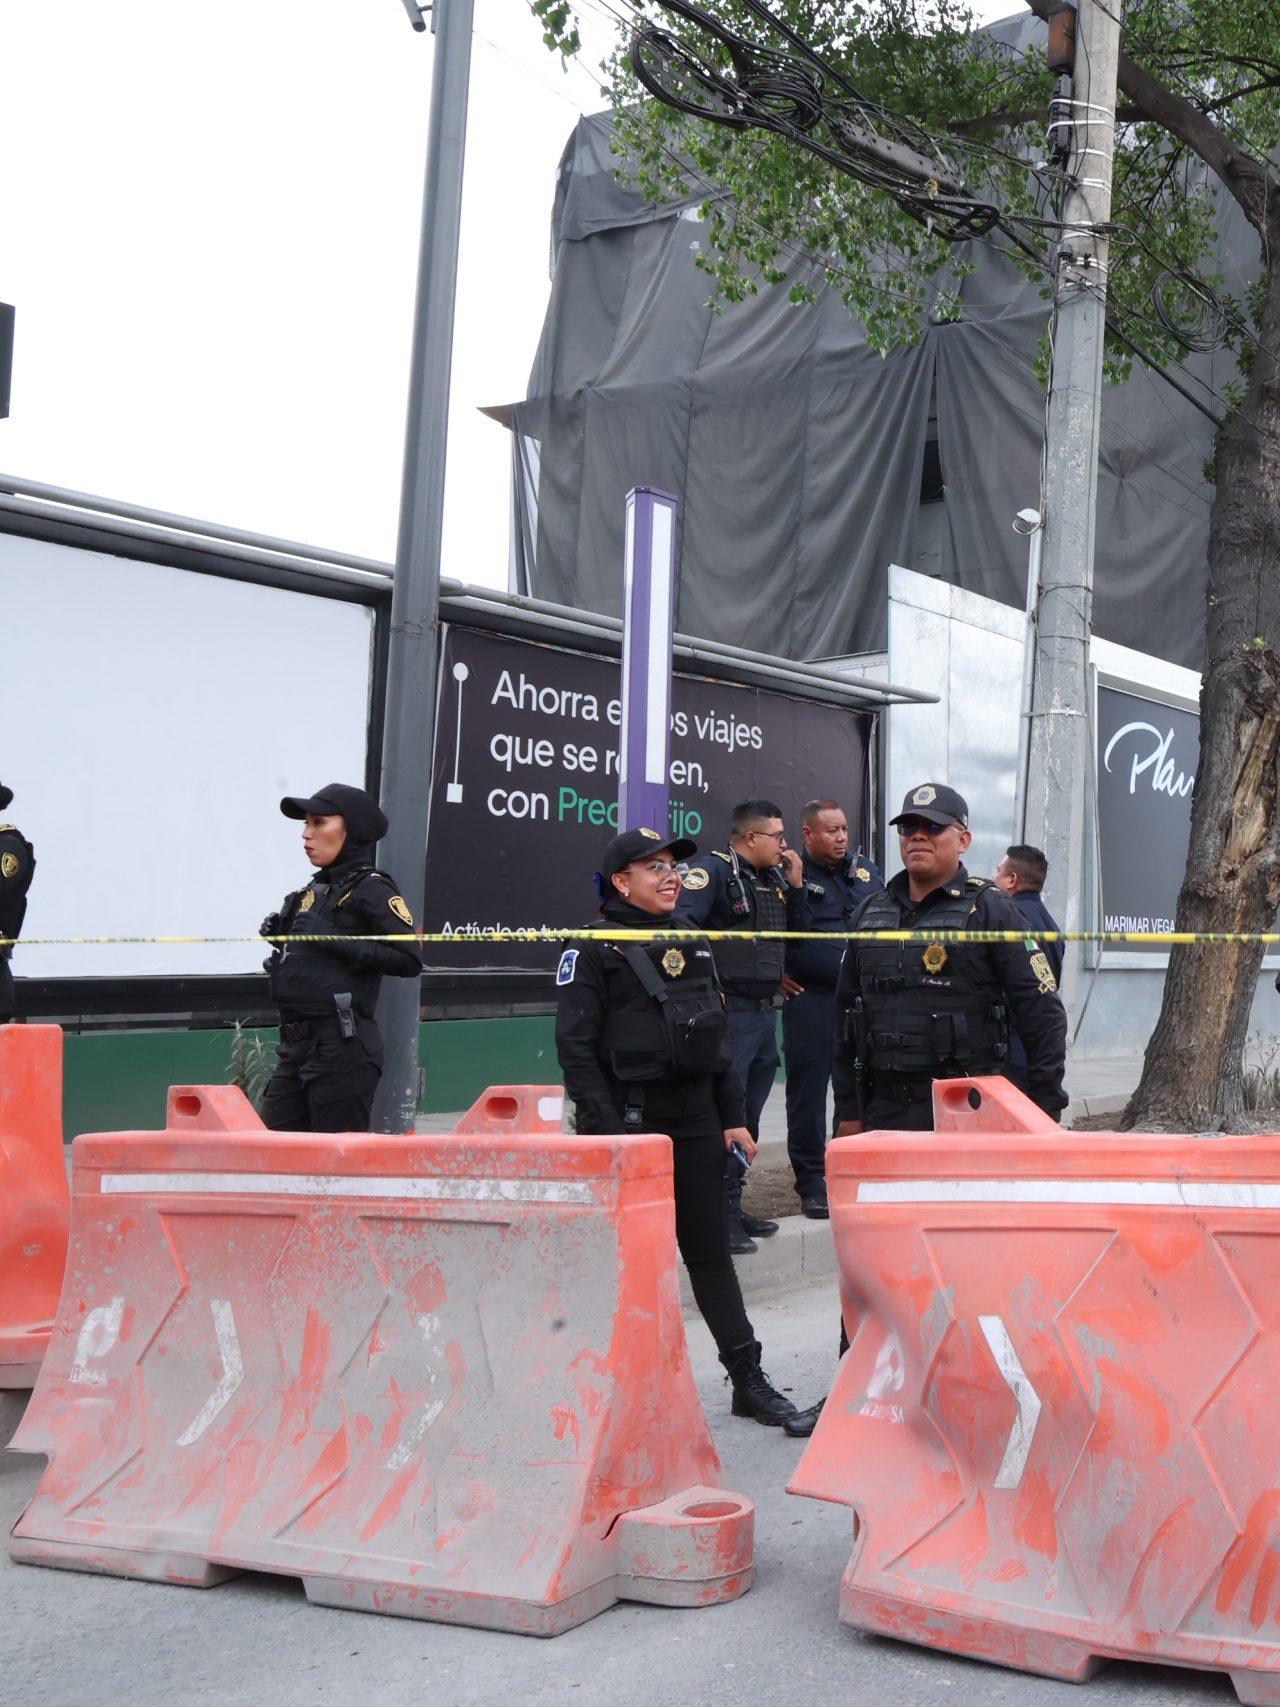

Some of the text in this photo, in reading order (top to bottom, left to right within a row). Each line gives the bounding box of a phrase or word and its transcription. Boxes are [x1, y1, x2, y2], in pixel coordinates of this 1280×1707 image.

[491, 670, 599, 722] Ahorra
[693, 710, 763, 753] viajes
[490, 733, 555, 772] que
[562, 743, 598, 773] se
[487, 788, 549, 821] con
[1104, 915, 1176, 934] MARIMAR VEGA
